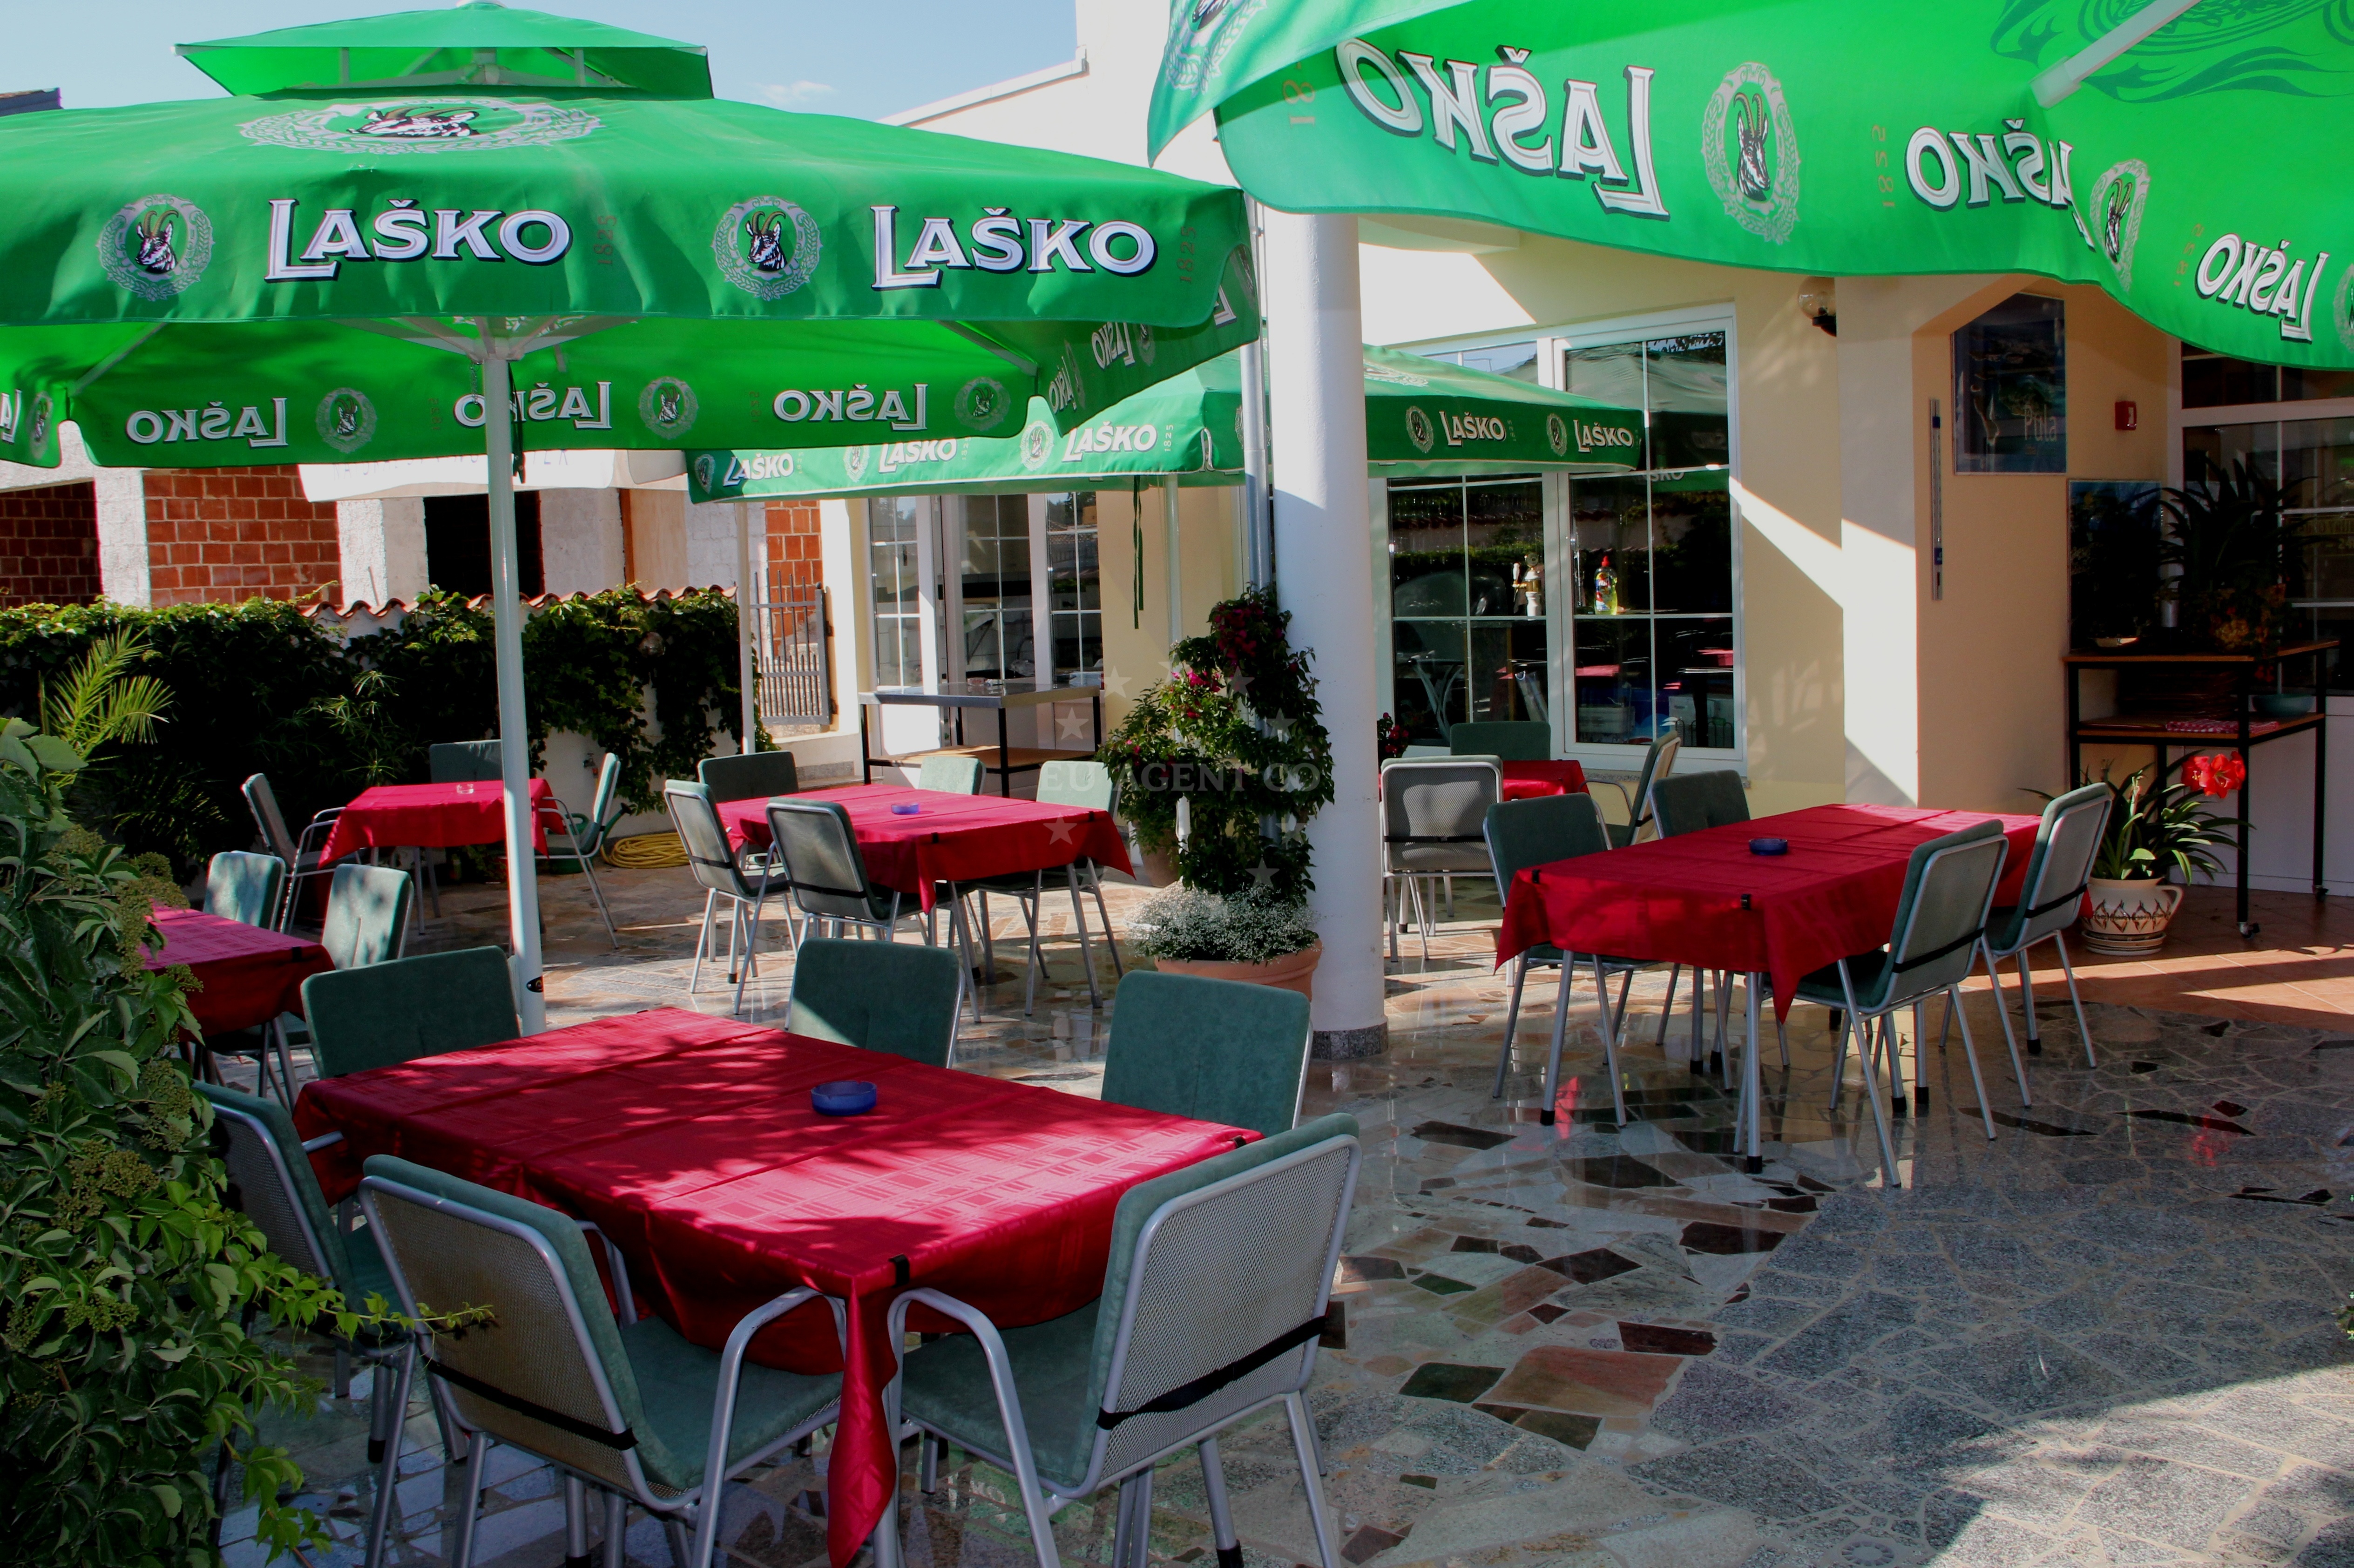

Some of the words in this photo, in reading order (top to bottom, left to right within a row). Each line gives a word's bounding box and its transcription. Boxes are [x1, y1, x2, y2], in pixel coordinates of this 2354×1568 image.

[264, 199, 574, 283] LAŠKO
[593, 215, 617, 266] 1825
[871, 205, 1158, 292] LAŠKO
[1176, 226, 1197, 283] 1825
[1062, 421, 1158, 462] LAŠKO
[1163, 424, 1174, 452] 1825
[1439, 411, 1507, 447] LAŠKO
[1573, 419, 1634, 453] LAŠKO
[2024, 404, 2058, 442] Pula
[722, 453, 794, 487] LAŠKO
